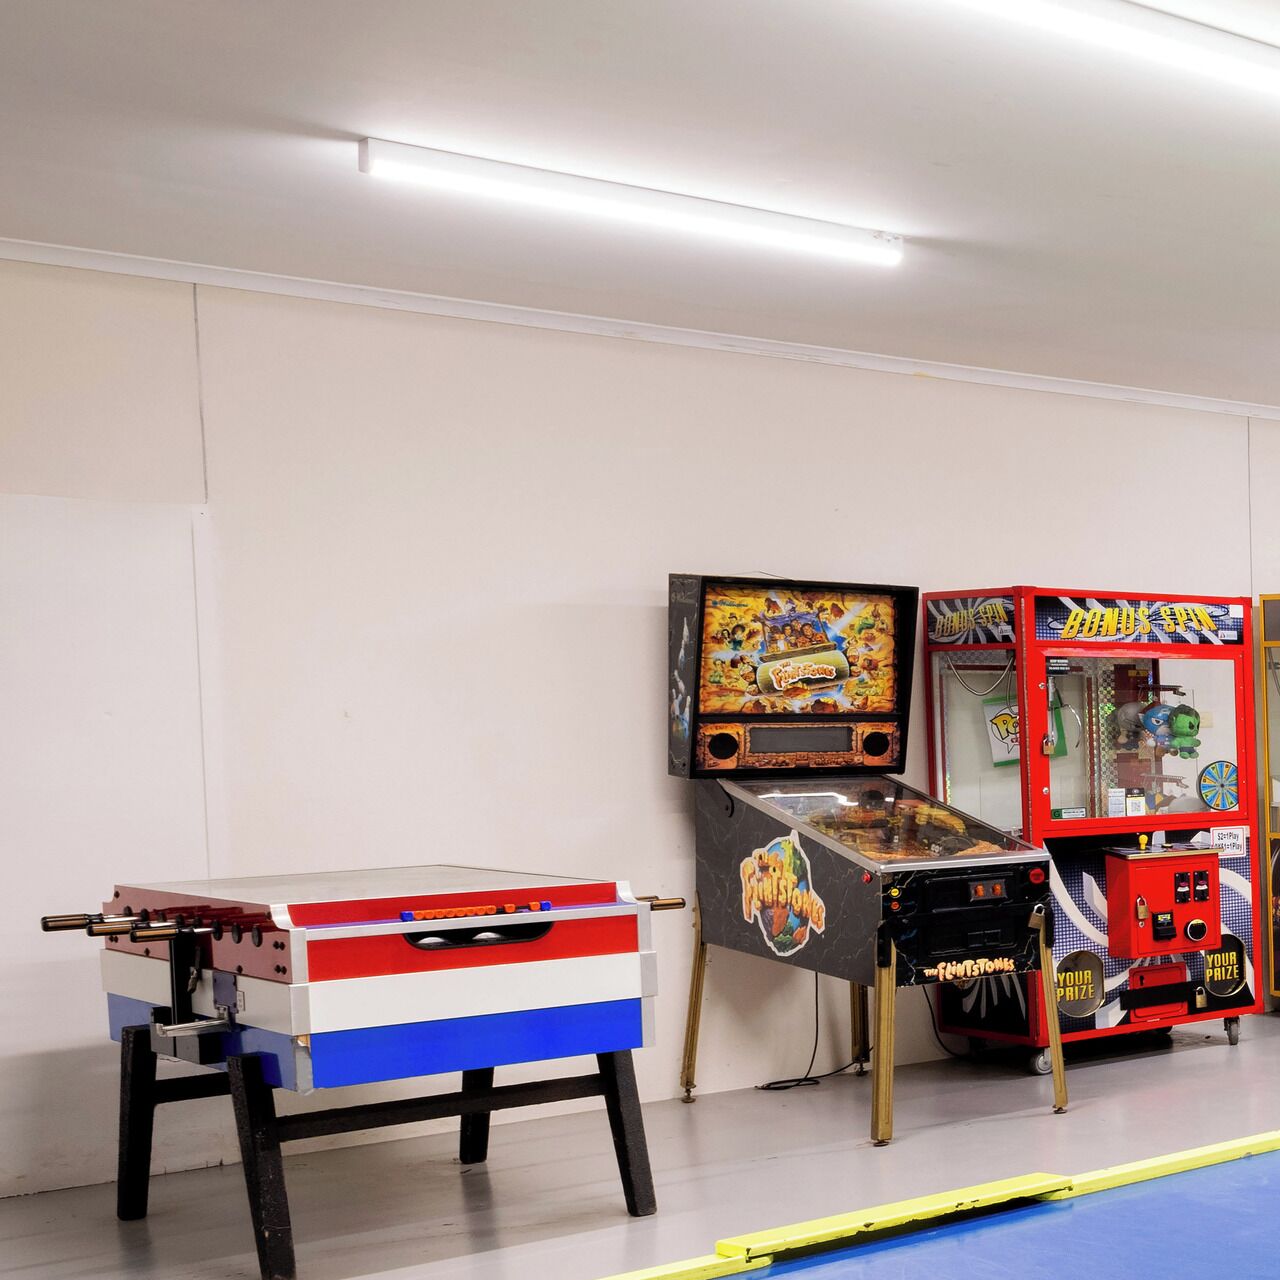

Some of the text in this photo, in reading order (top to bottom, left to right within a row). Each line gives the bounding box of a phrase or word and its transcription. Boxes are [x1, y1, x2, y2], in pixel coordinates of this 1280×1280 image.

[935, 603, 1008, 639] BONUS SPIN
[1060, 605, 1218, 639] BONUS SPIN
[923, 957, 1015, 981] THE FLINTSTONES
[1206, 951, 1237, 968] YOUR
[1057, 969, 1092, 987] YOUR
[1206, 964, 1239, 983] PRIZE
[1056, 984, 1095, 1001] PRIZE
